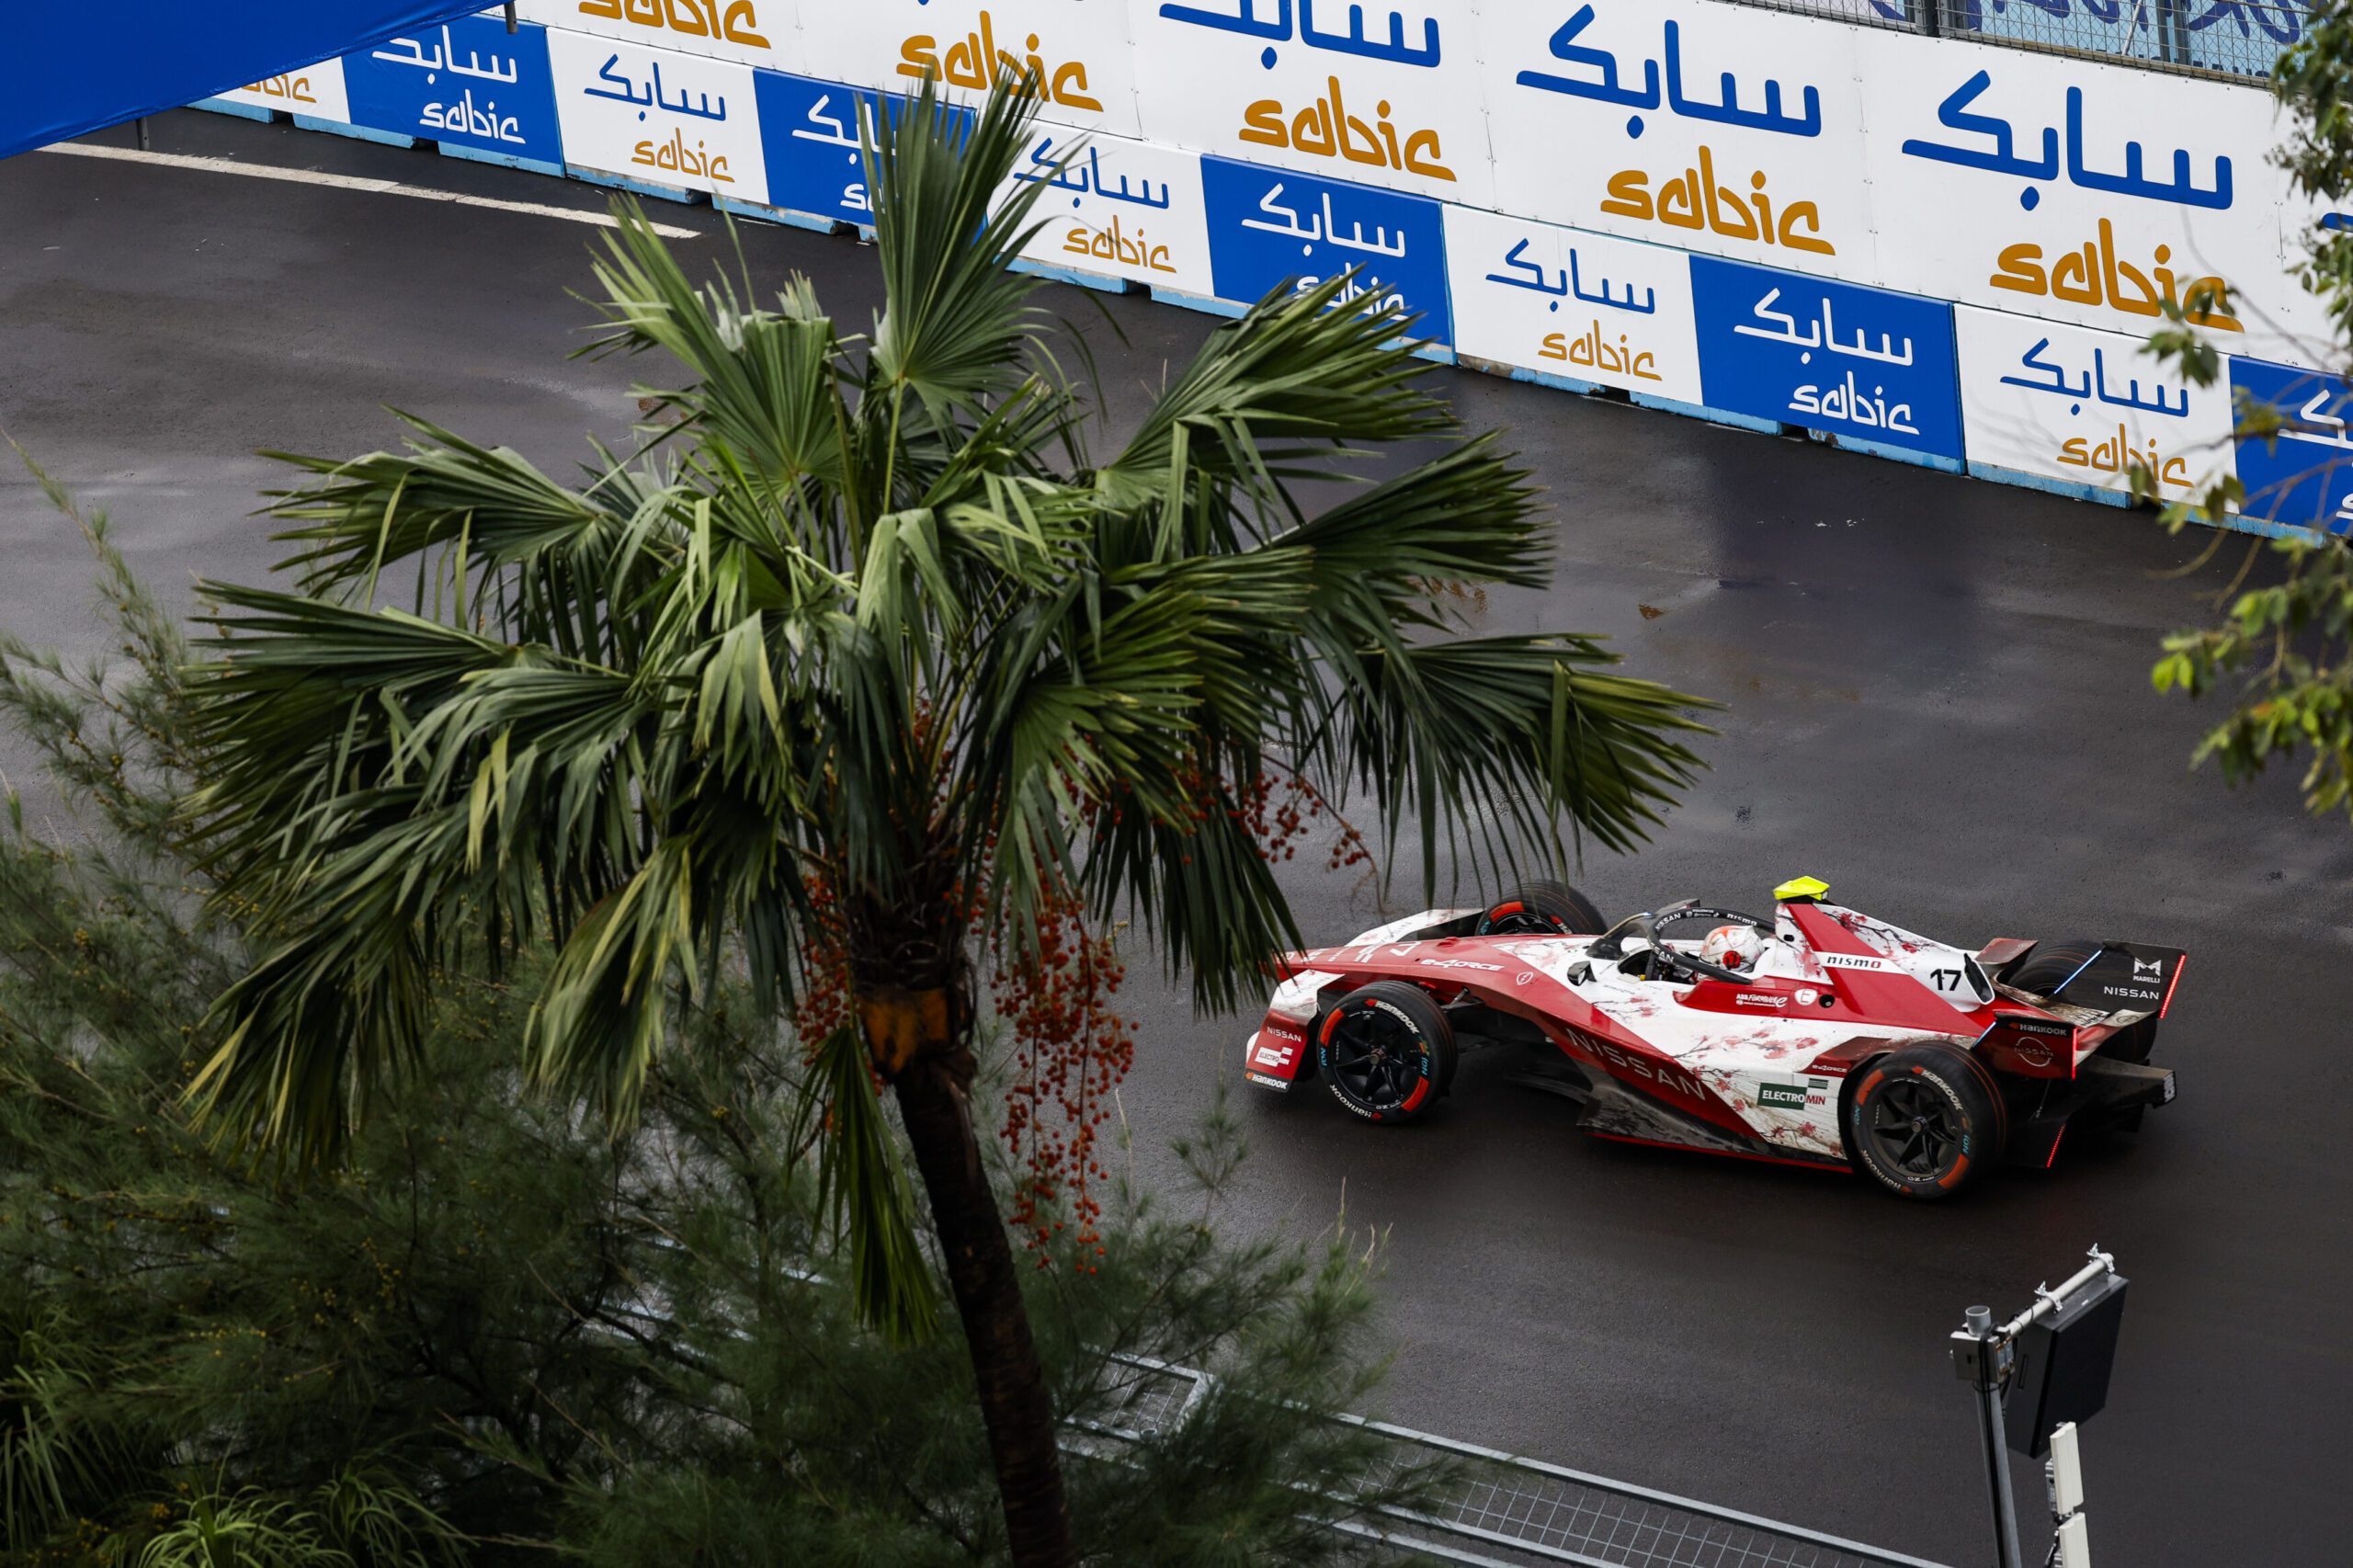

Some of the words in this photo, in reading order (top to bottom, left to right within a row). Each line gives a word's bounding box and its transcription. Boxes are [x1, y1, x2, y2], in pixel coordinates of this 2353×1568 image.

[584, 53, 726, 121] سابك
[896, 10, 1104, 112] sabic
[1516, 4, 1821, 139] سابك
[419, 89, 527, 144] sabic
[1239, 75, 1457, 182] sabic
[1902, 69, 2234, 210] سابك
[631, 127, 735, 183] sabic
[1014, 137, 1169, 210] سابك
[1241, 183, 1406, 257] سابك
[1600, 145, 1836, 256] sabic
[1063, 215, 1176, 273] sabic
[1485, 238, 1655, 314] سابك
[1989, 217, 2245, 333] sabic
[1538, 320, 1663, 381] sabic
[1733, 287, 1914, 366] سابك
[1789, 371, 1920, 435] sabic
[2000, 337, 2189, 418] سابك
[2057, 423, 2194, 488] sabic
[1930, 969, 1961, 992] 17
[2103, 985, 2160, 1000] NISSAN
[2132, 975, 2161, 983] MARELLI
[1267, 1026, 1302, 1042] NISSAN
[1565, 1028, 1706, 1101] NISSAN
